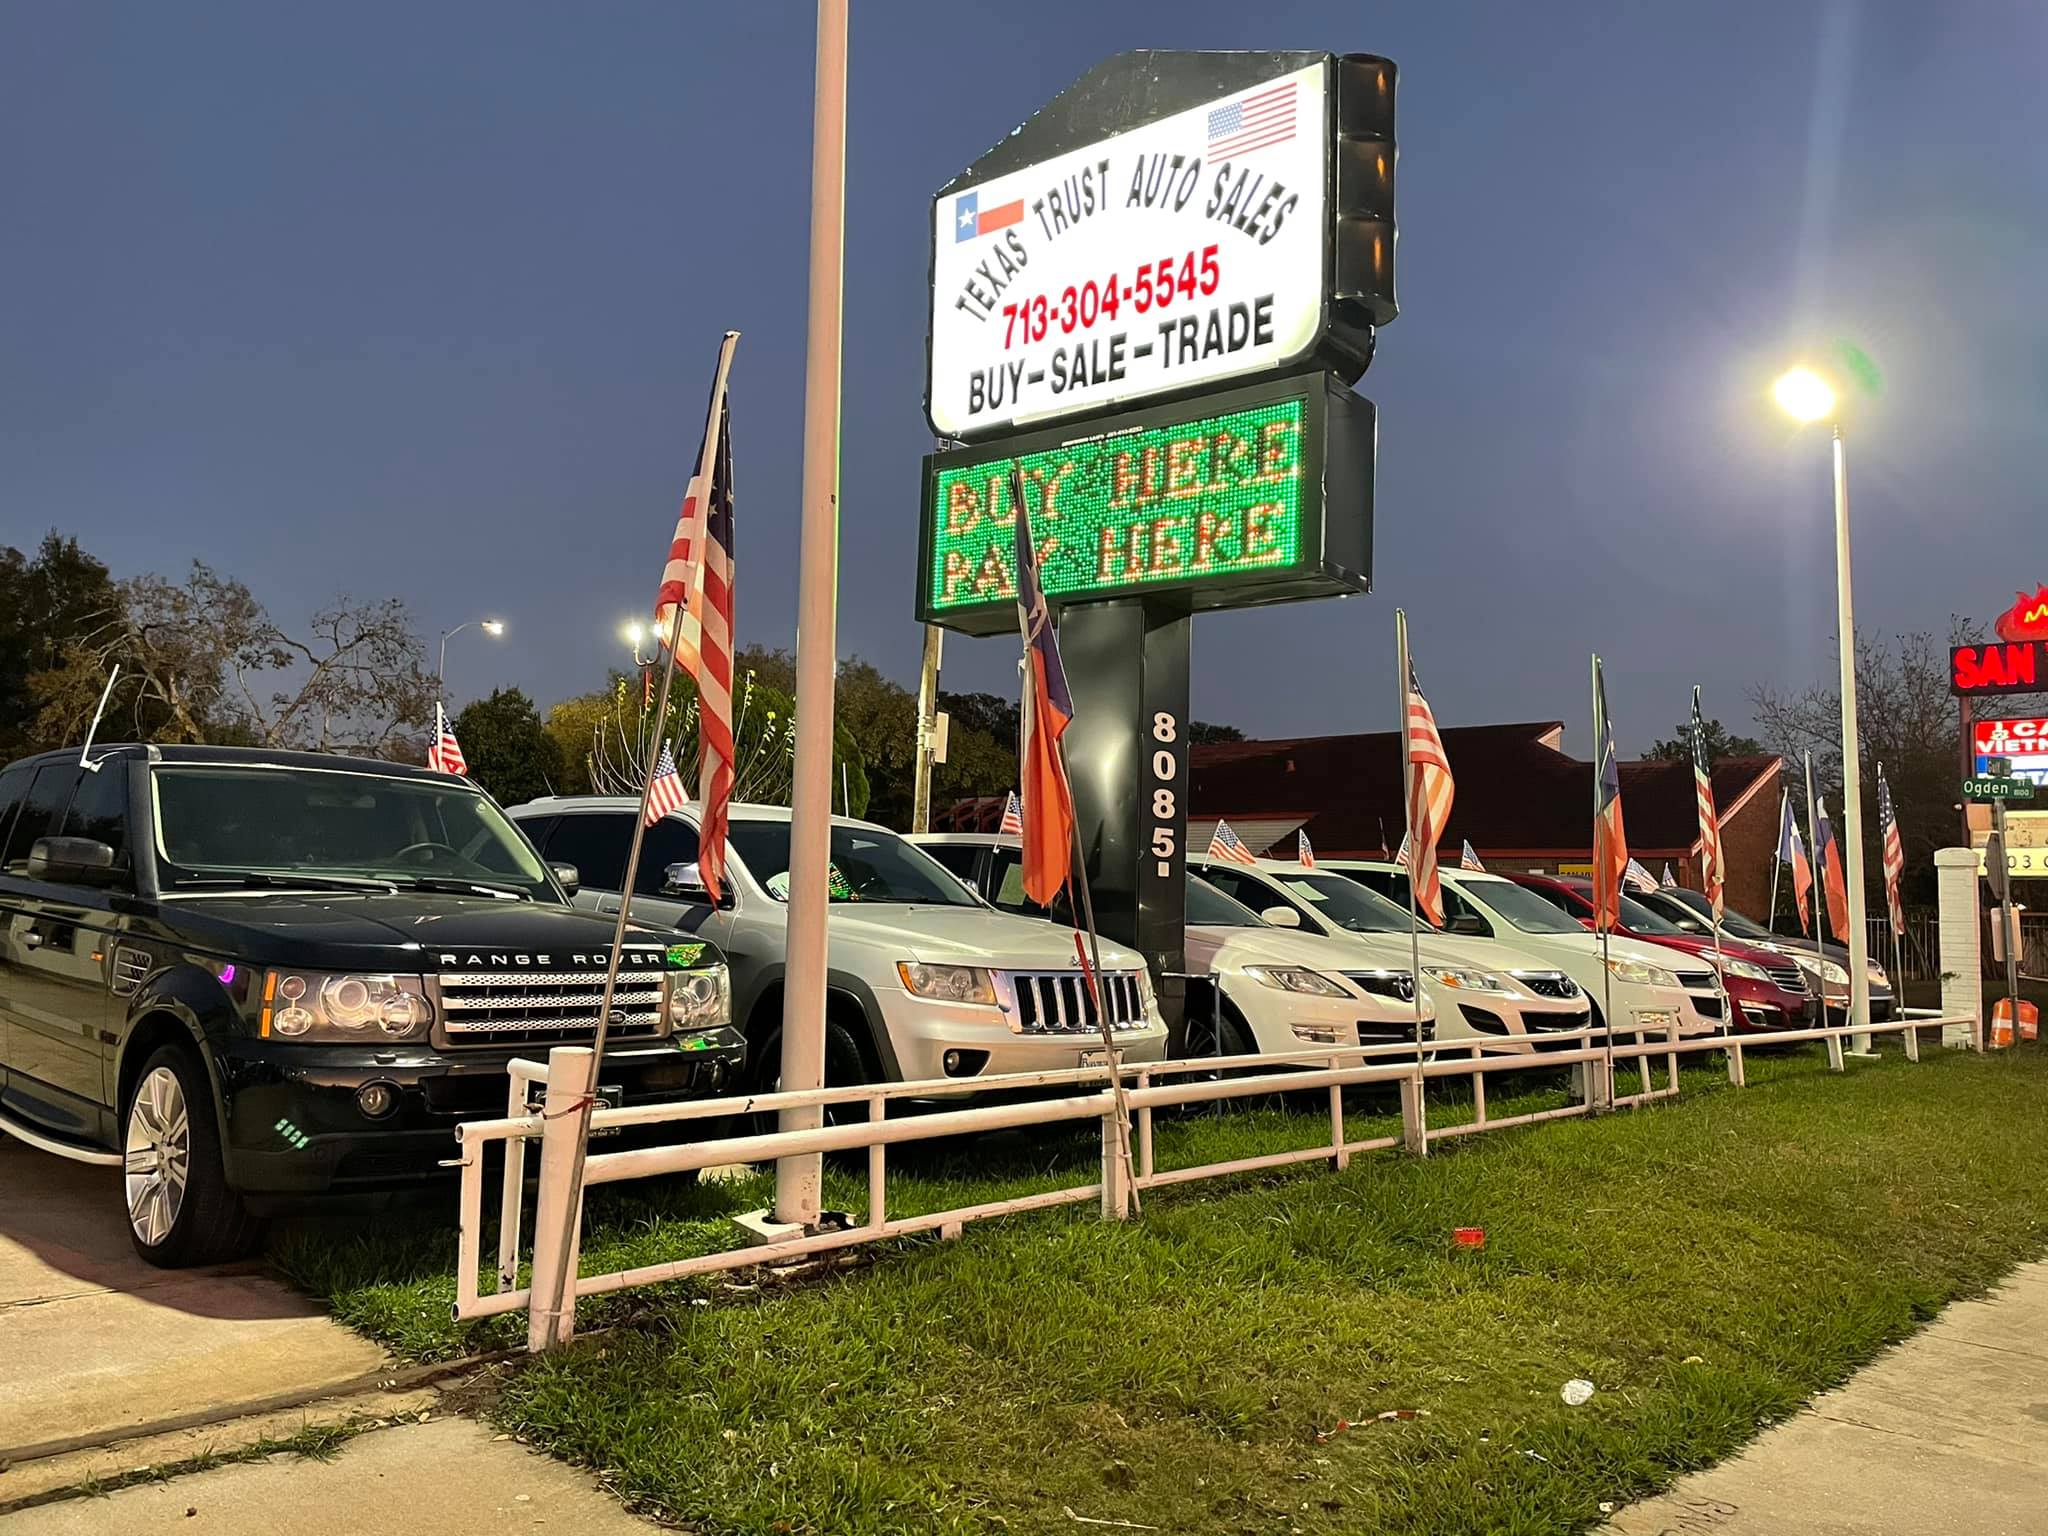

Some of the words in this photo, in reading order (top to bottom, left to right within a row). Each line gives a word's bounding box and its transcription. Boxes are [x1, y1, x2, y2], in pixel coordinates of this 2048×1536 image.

[956, 226, 1028, 322] TEXAS
[1032, 158, 1110, 241] TRUST
[1126, 153, 1201, 213] AUTO
[1206, 162, 1299, 246] SALES
[1002, 244, 1220, 350] 713-304-5545
[945, 461, 1074, 536] BUY
[1107, 420, 1301, 508] HERE
[1095, 502, 1286, 583] HERE
[1954, 642, 2035, 689] SAN
[1963, 780, 2009, 797] Ogden
[439, 954, 552, 966] RANGE
